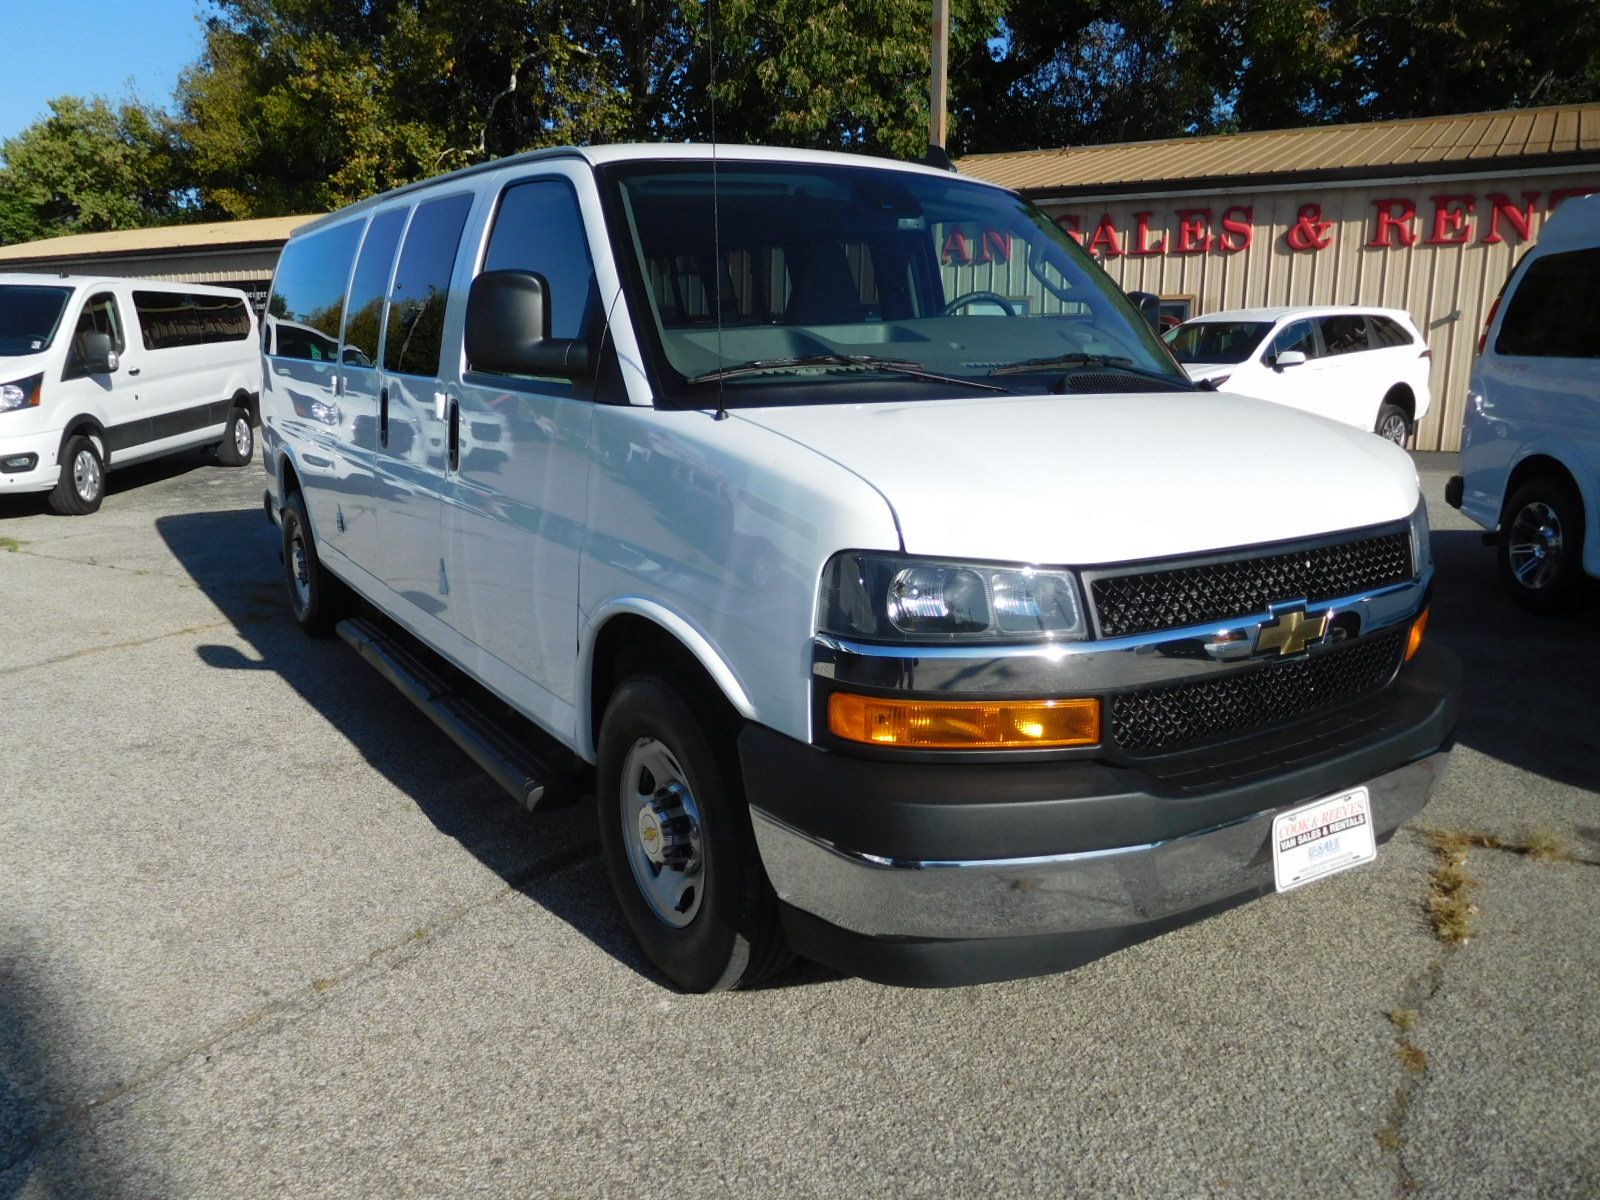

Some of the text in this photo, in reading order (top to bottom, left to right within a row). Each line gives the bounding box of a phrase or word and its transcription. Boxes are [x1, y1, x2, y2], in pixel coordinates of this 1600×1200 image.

[1287, 203, 1333, 251] &
[1279, 801, 1364, 837] COOK & REEVES
[1281, 815, 1364, 851] VAN SALES & RENTALS
